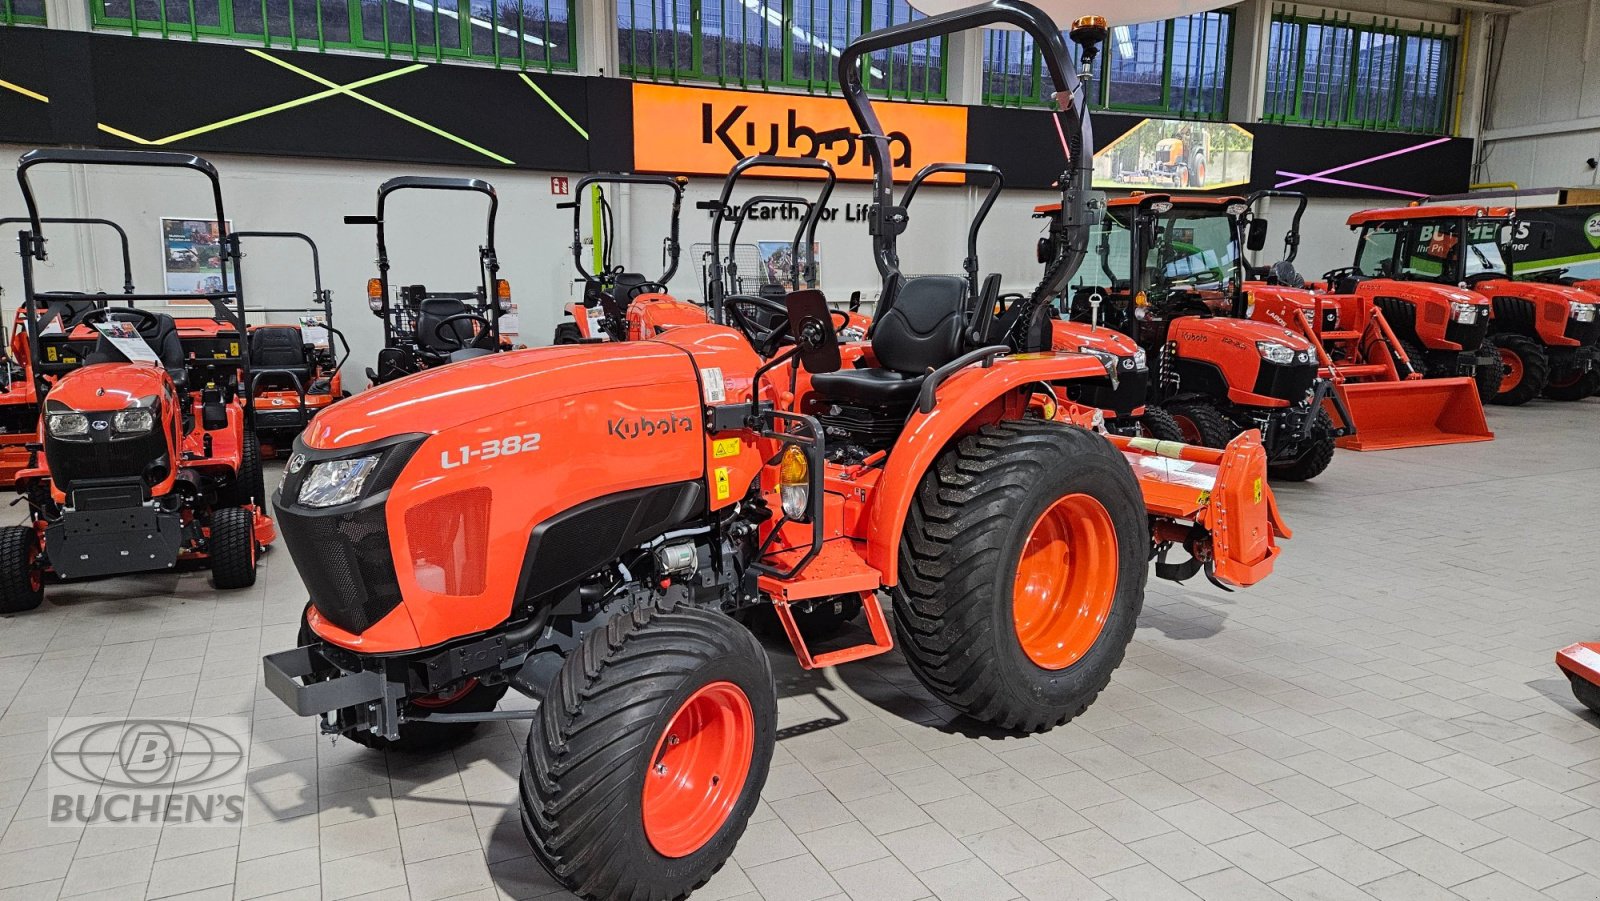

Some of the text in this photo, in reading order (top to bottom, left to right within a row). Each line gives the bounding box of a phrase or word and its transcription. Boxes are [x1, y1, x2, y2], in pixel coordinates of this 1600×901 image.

[811, 203, 839, 221] or
[845, 203, 872, 222] Lif
[608, 412, 693, 440] Kubota
[440, 433, 541, 469] L1-382
